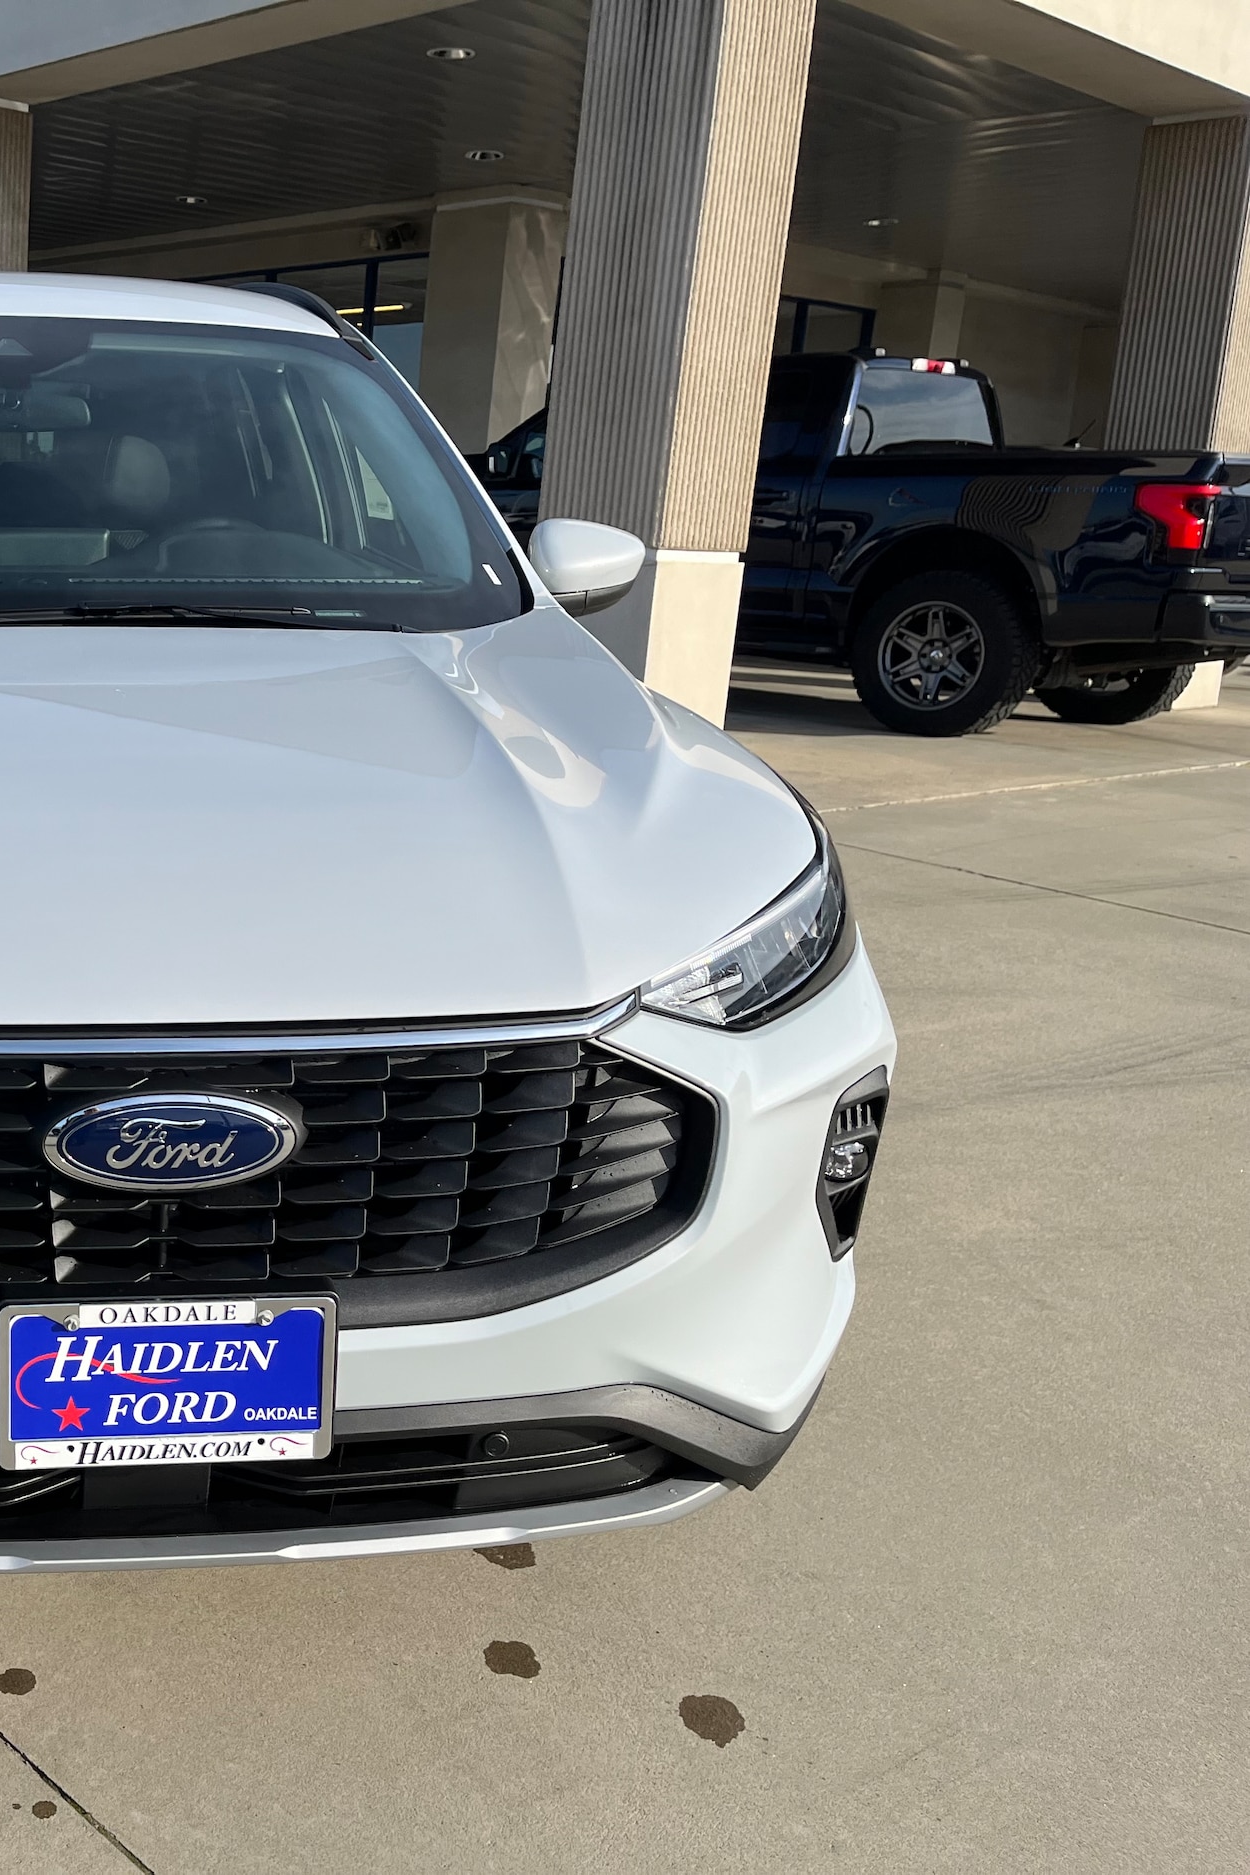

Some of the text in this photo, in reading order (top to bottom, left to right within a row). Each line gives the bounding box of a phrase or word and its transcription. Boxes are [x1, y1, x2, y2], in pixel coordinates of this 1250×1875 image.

[106, 1117, 238, 1169] Ford
[100, 1305, 237, 1324] OAKDALE
[45, 1336, 279, 1383] HAIDLEN
[103, 1391, 318, 1426] FORD OAKDALE
[75, 1441, 253, 1465] HAIDLEN.COM
